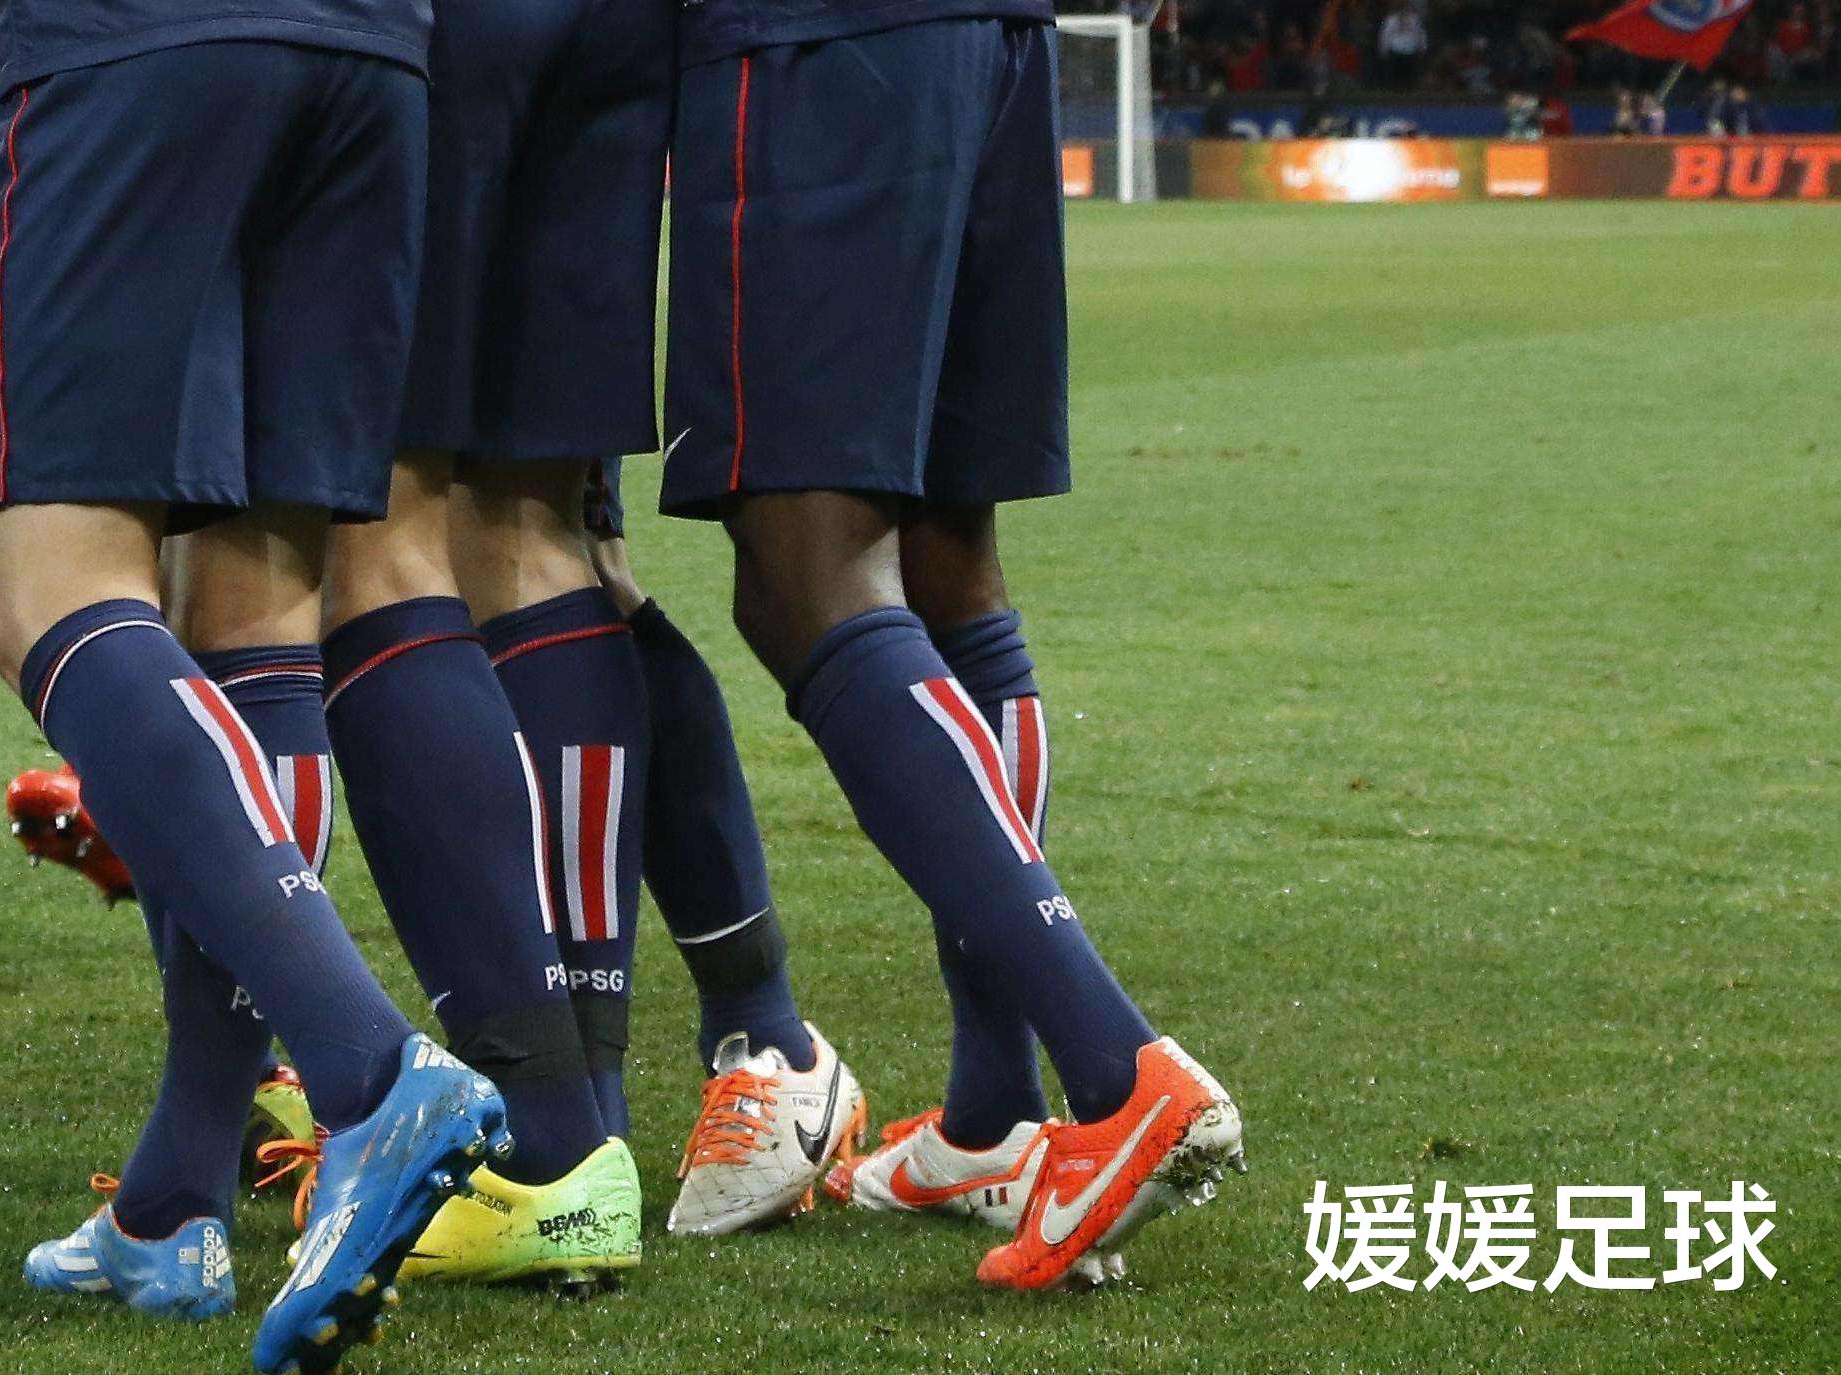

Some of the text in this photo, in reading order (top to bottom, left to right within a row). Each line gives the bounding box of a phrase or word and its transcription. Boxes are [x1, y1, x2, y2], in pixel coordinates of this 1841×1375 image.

[1664, 142, 1841, 200] BUT
[278, 870, 328, 899] PS
[1036, 894, 1078, 926] PS
[544, 962, 568, 991] PS
[569, 968, 625, 993] PSG
